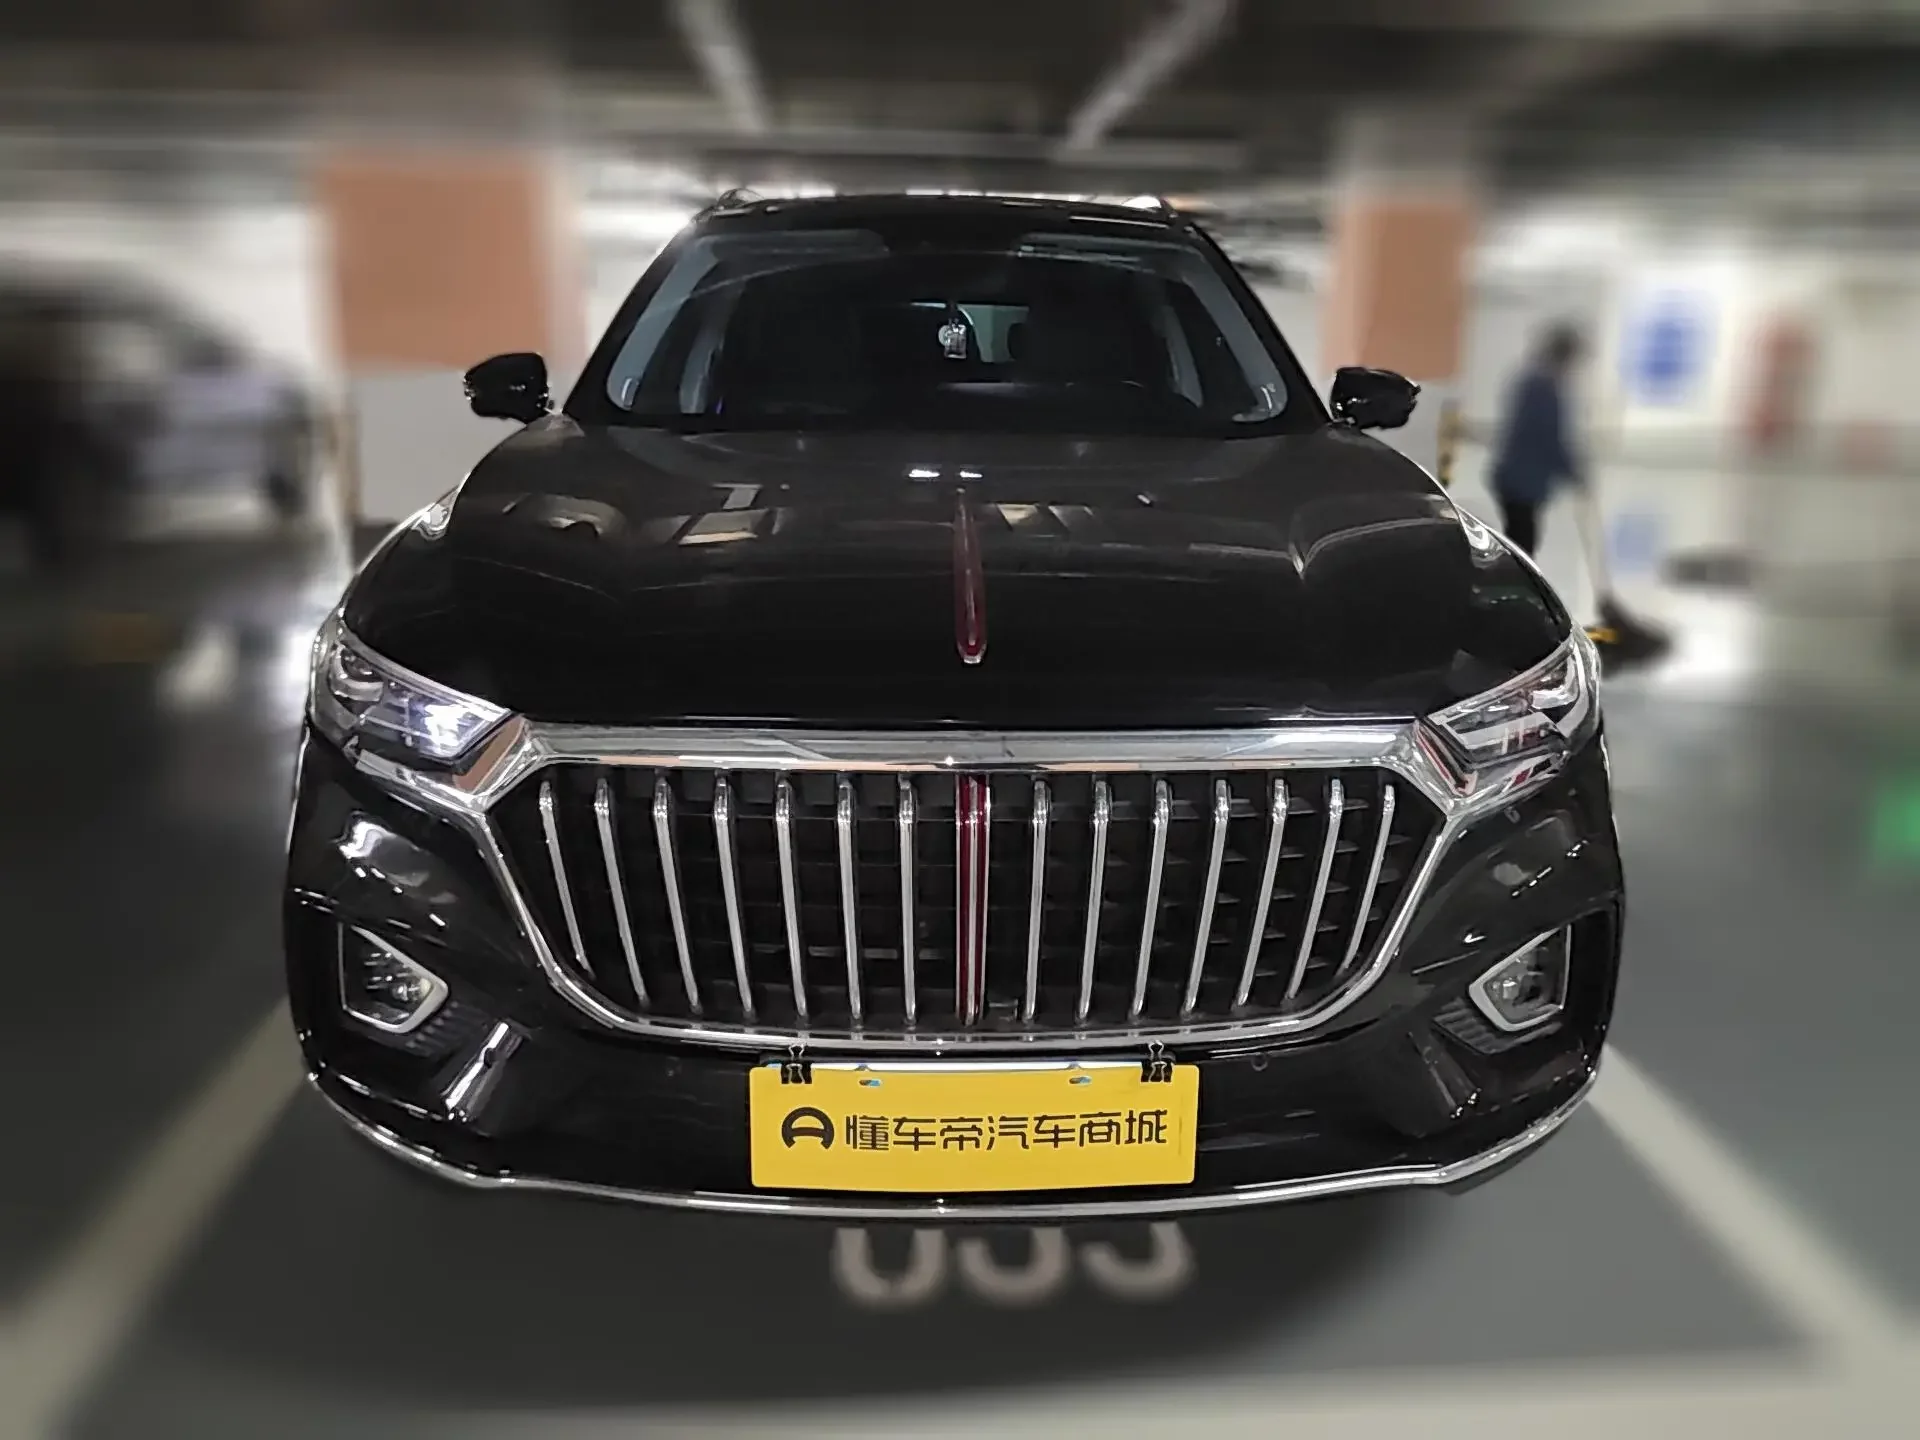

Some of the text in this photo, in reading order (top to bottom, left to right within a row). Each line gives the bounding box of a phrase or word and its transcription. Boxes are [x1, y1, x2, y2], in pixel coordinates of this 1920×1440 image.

[845, 1109, 1168, 1151] 懂车帝汽车商城
